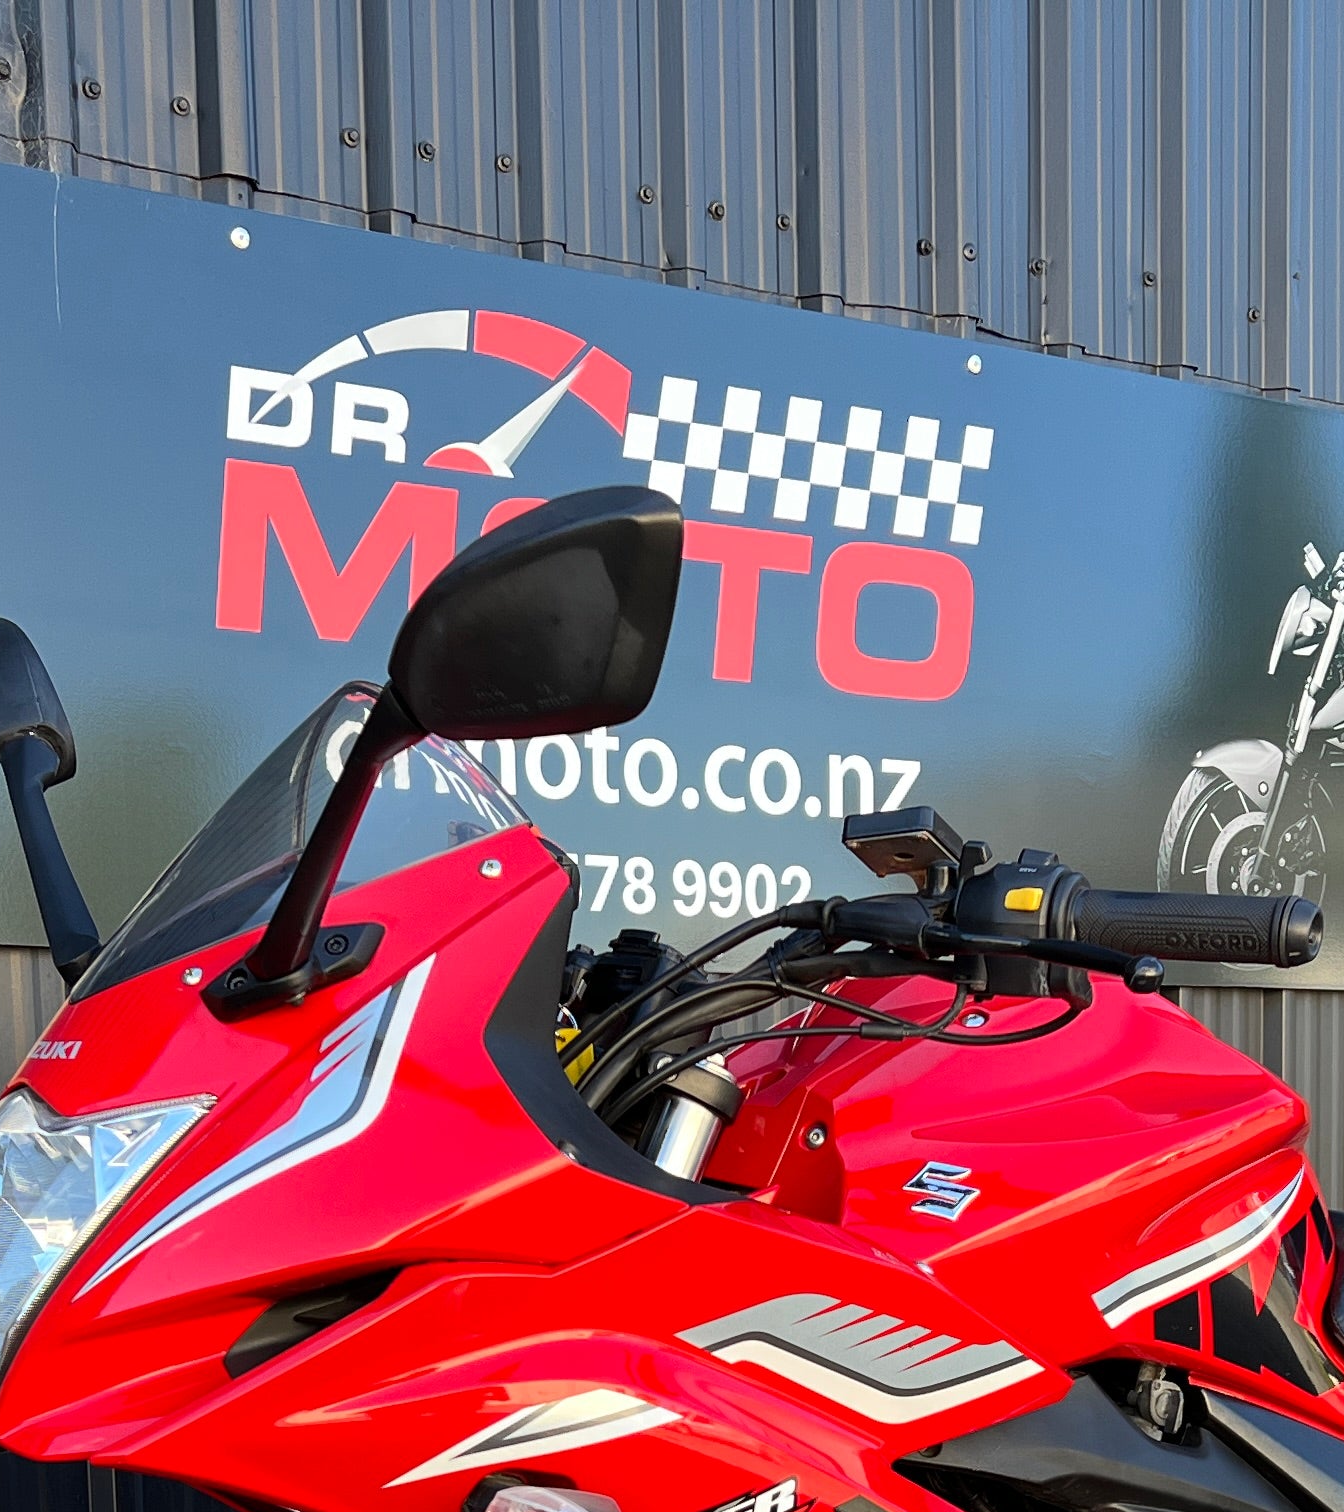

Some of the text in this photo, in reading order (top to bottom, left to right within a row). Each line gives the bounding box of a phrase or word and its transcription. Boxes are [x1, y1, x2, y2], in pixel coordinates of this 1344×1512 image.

[228, 366, 409, 463] DR
[215, 458, 975, 702] MTO
[570, 853, 812, 919] 78 9902
[1165, 932, 1259, 954] OXFORD
